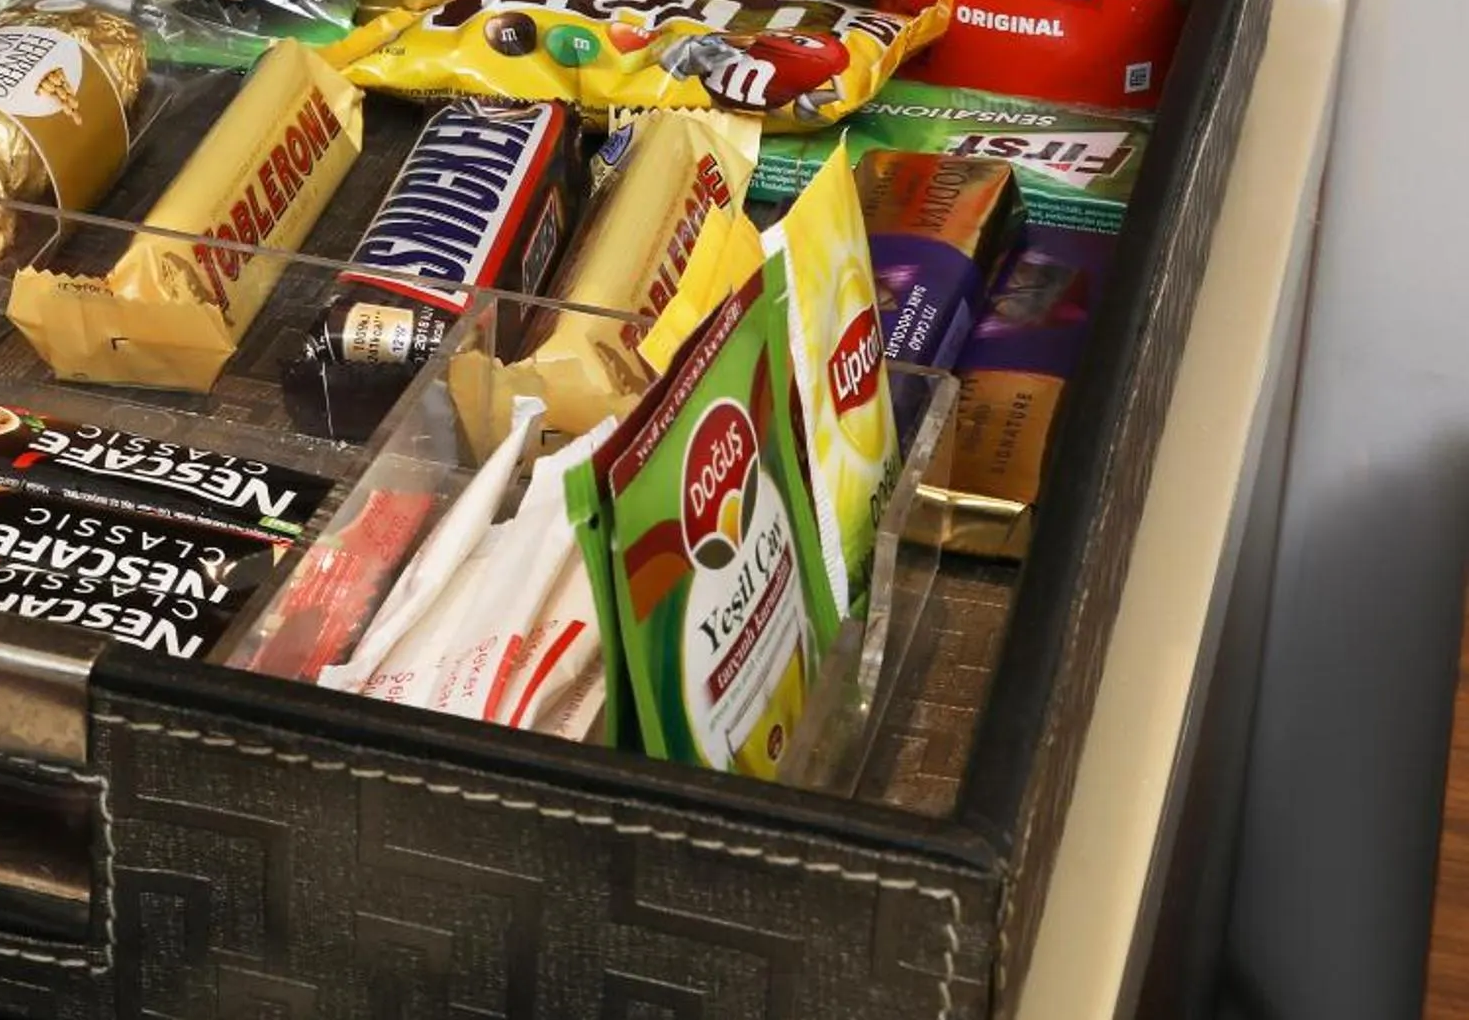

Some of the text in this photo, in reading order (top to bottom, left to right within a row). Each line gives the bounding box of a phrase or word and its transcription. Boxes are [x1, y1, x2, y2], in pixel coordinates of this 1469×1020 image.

[500, 26, 518, 43] m
[956, 5, 1064, 37] ORIGINAL
[705, 54, 779, 108] m
[190, 85, 342, 312] TOBLERONE
[832, 324, 881, 401] Lipto
[76, 424, 270, 476] CLASSIC
[689, 420, 745, 518] DOĞUŞ
[23, 506, 227, 567] CLASSIC
[698, 568, 756, 655] Yeşil
